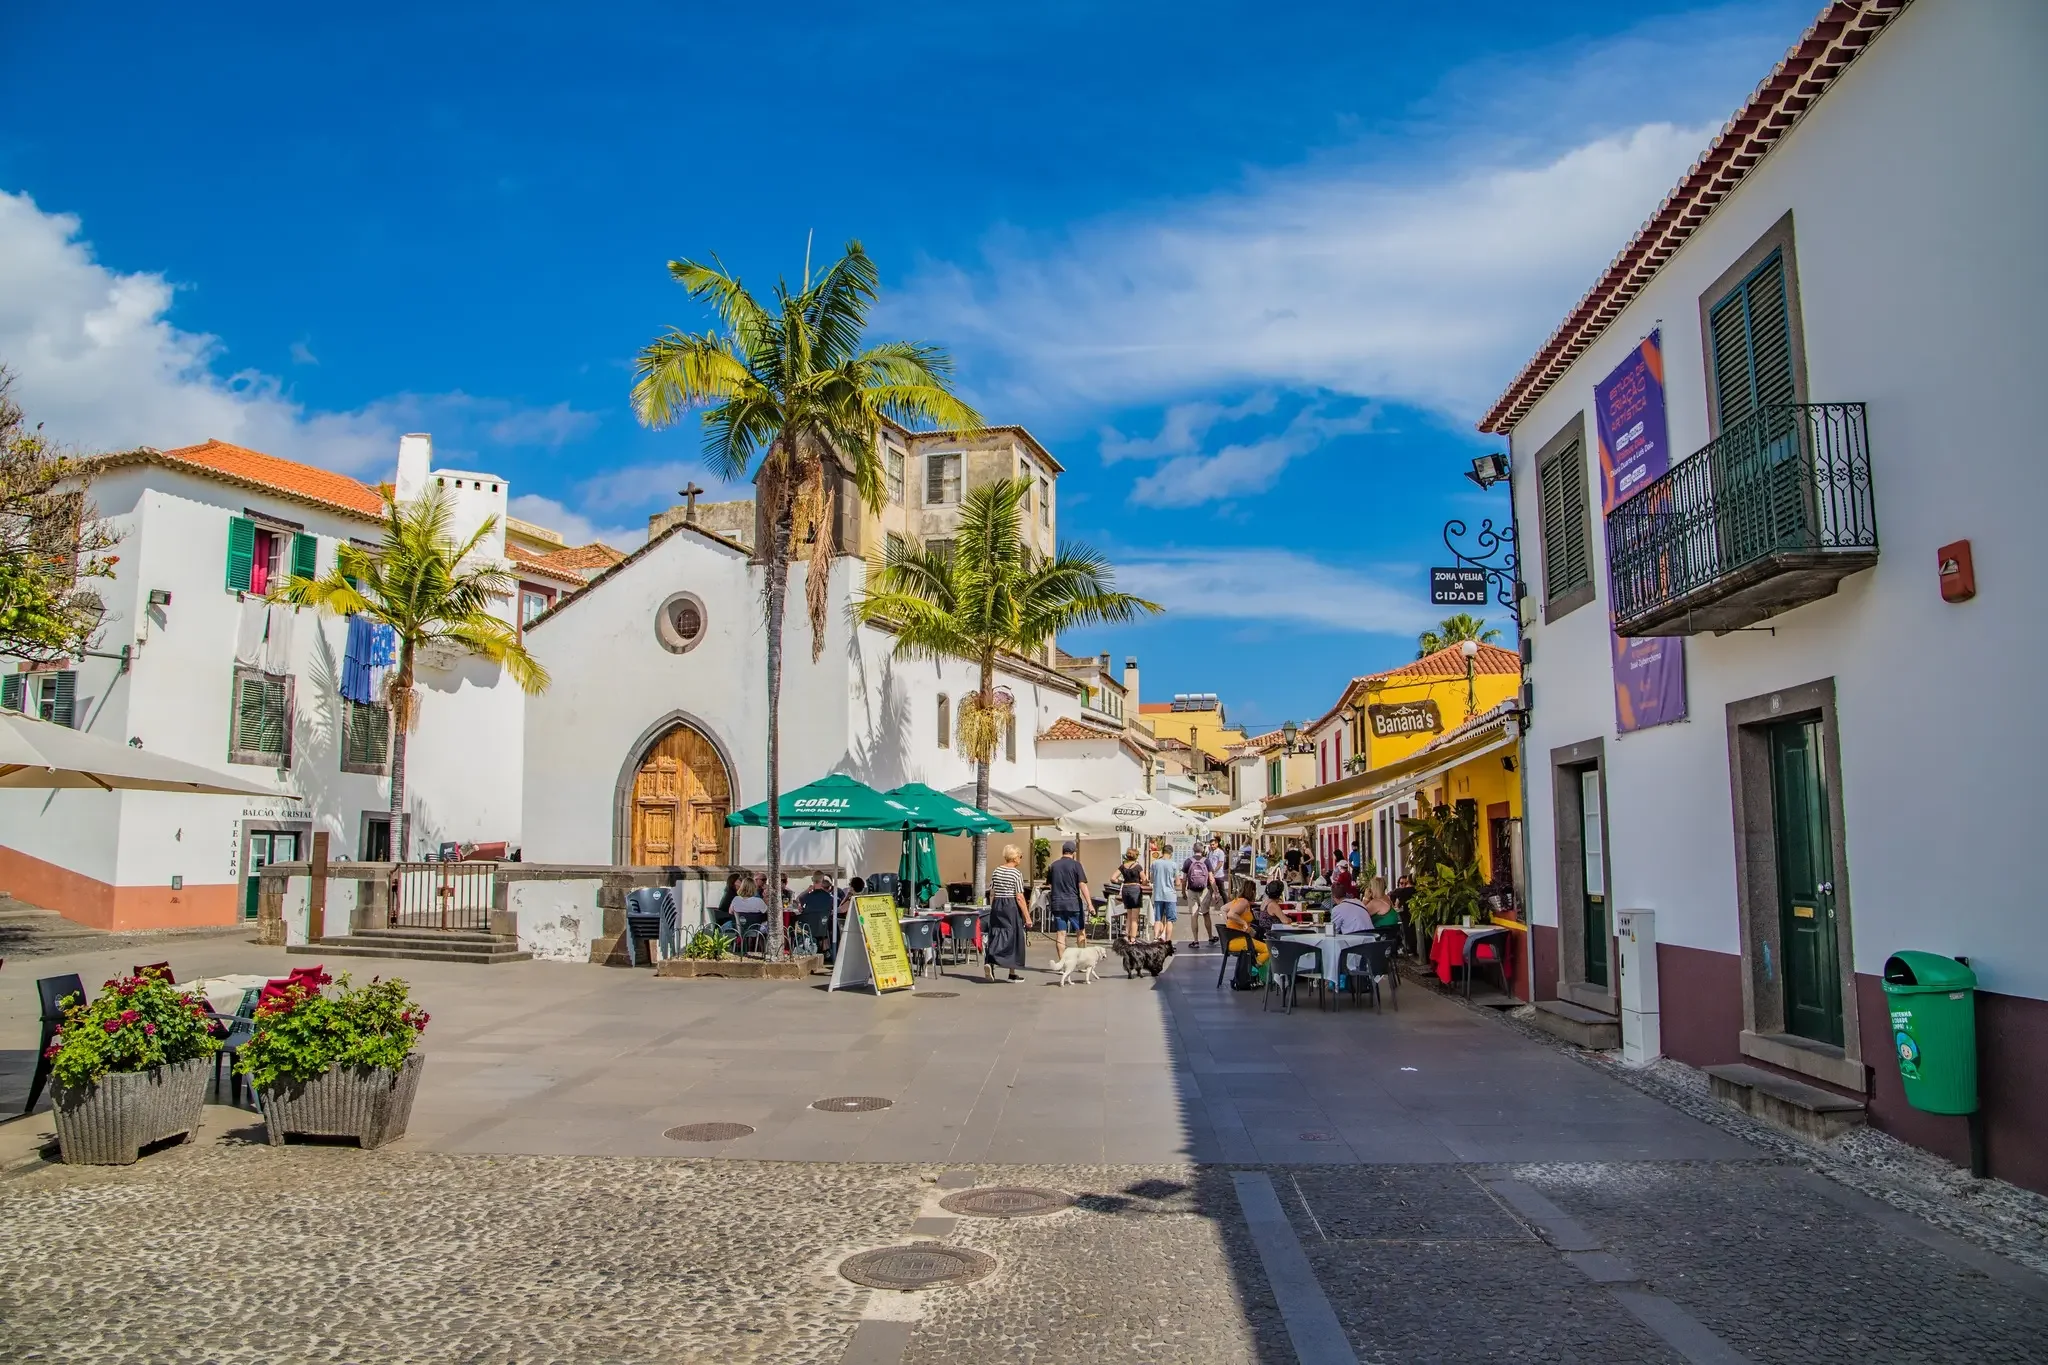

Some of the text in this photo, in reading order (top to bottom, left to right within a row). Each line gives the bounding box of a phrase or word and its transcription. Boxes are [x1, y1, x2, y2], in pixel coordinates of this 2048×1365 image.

[1635, 361, 1645, 377] DE
[1609, 376, 1646, 417] CRIAÇÃO
[1611, 395, 1647, 432] ARTÍSTICA
[1435, 572, 1483, 581] ZONA VELHA
[1454, 582, 1464, 590] DA
[1435, 591, 1484, 601] CIDADE
[1376, 709, 1434, 734] Banana's
[794, 798, 850, 808] CORAL
[242, 808, 312, 819] BALCÃO CRISTAL
[1115, 807, 1144, 817] CORAL
[1115, 825, 1134, 833] CORAL
[229, 820, 239, 877] TEATRO
